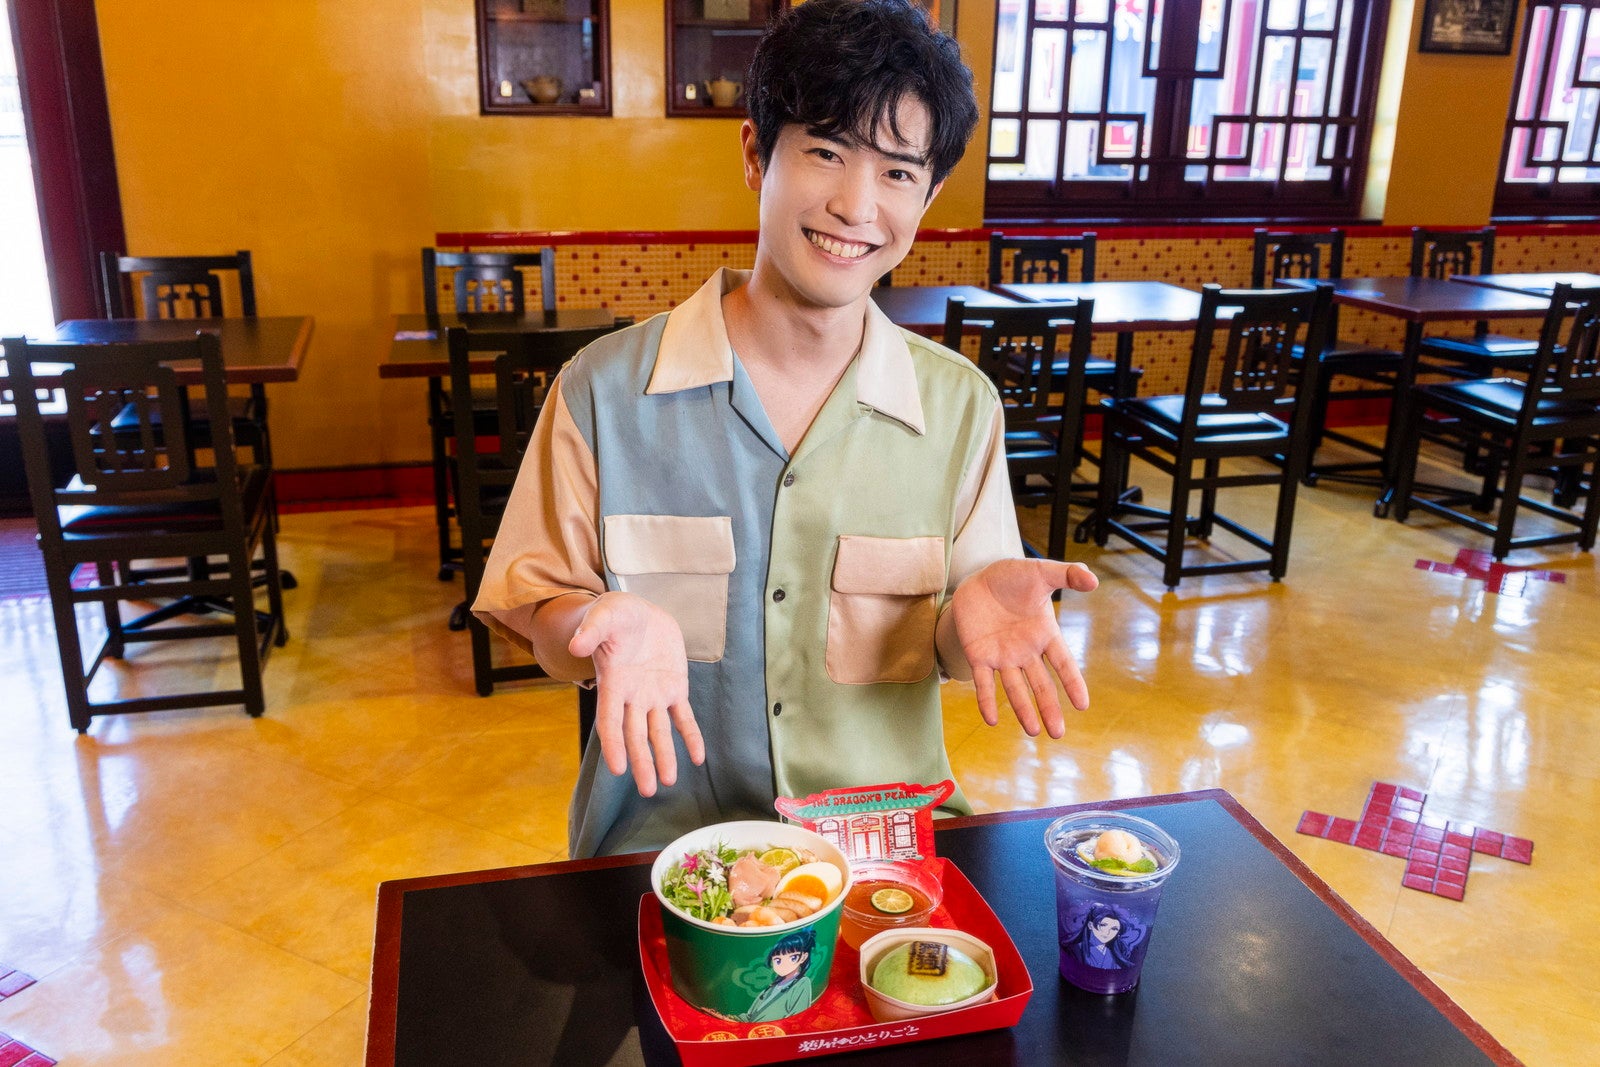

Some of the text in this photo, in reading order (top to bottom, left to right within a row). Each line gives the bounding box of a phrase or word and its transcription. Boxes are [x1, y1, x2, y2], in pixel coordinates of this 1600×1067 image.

[812, 790, 918, 808] THE DRAGON'S PEARL
